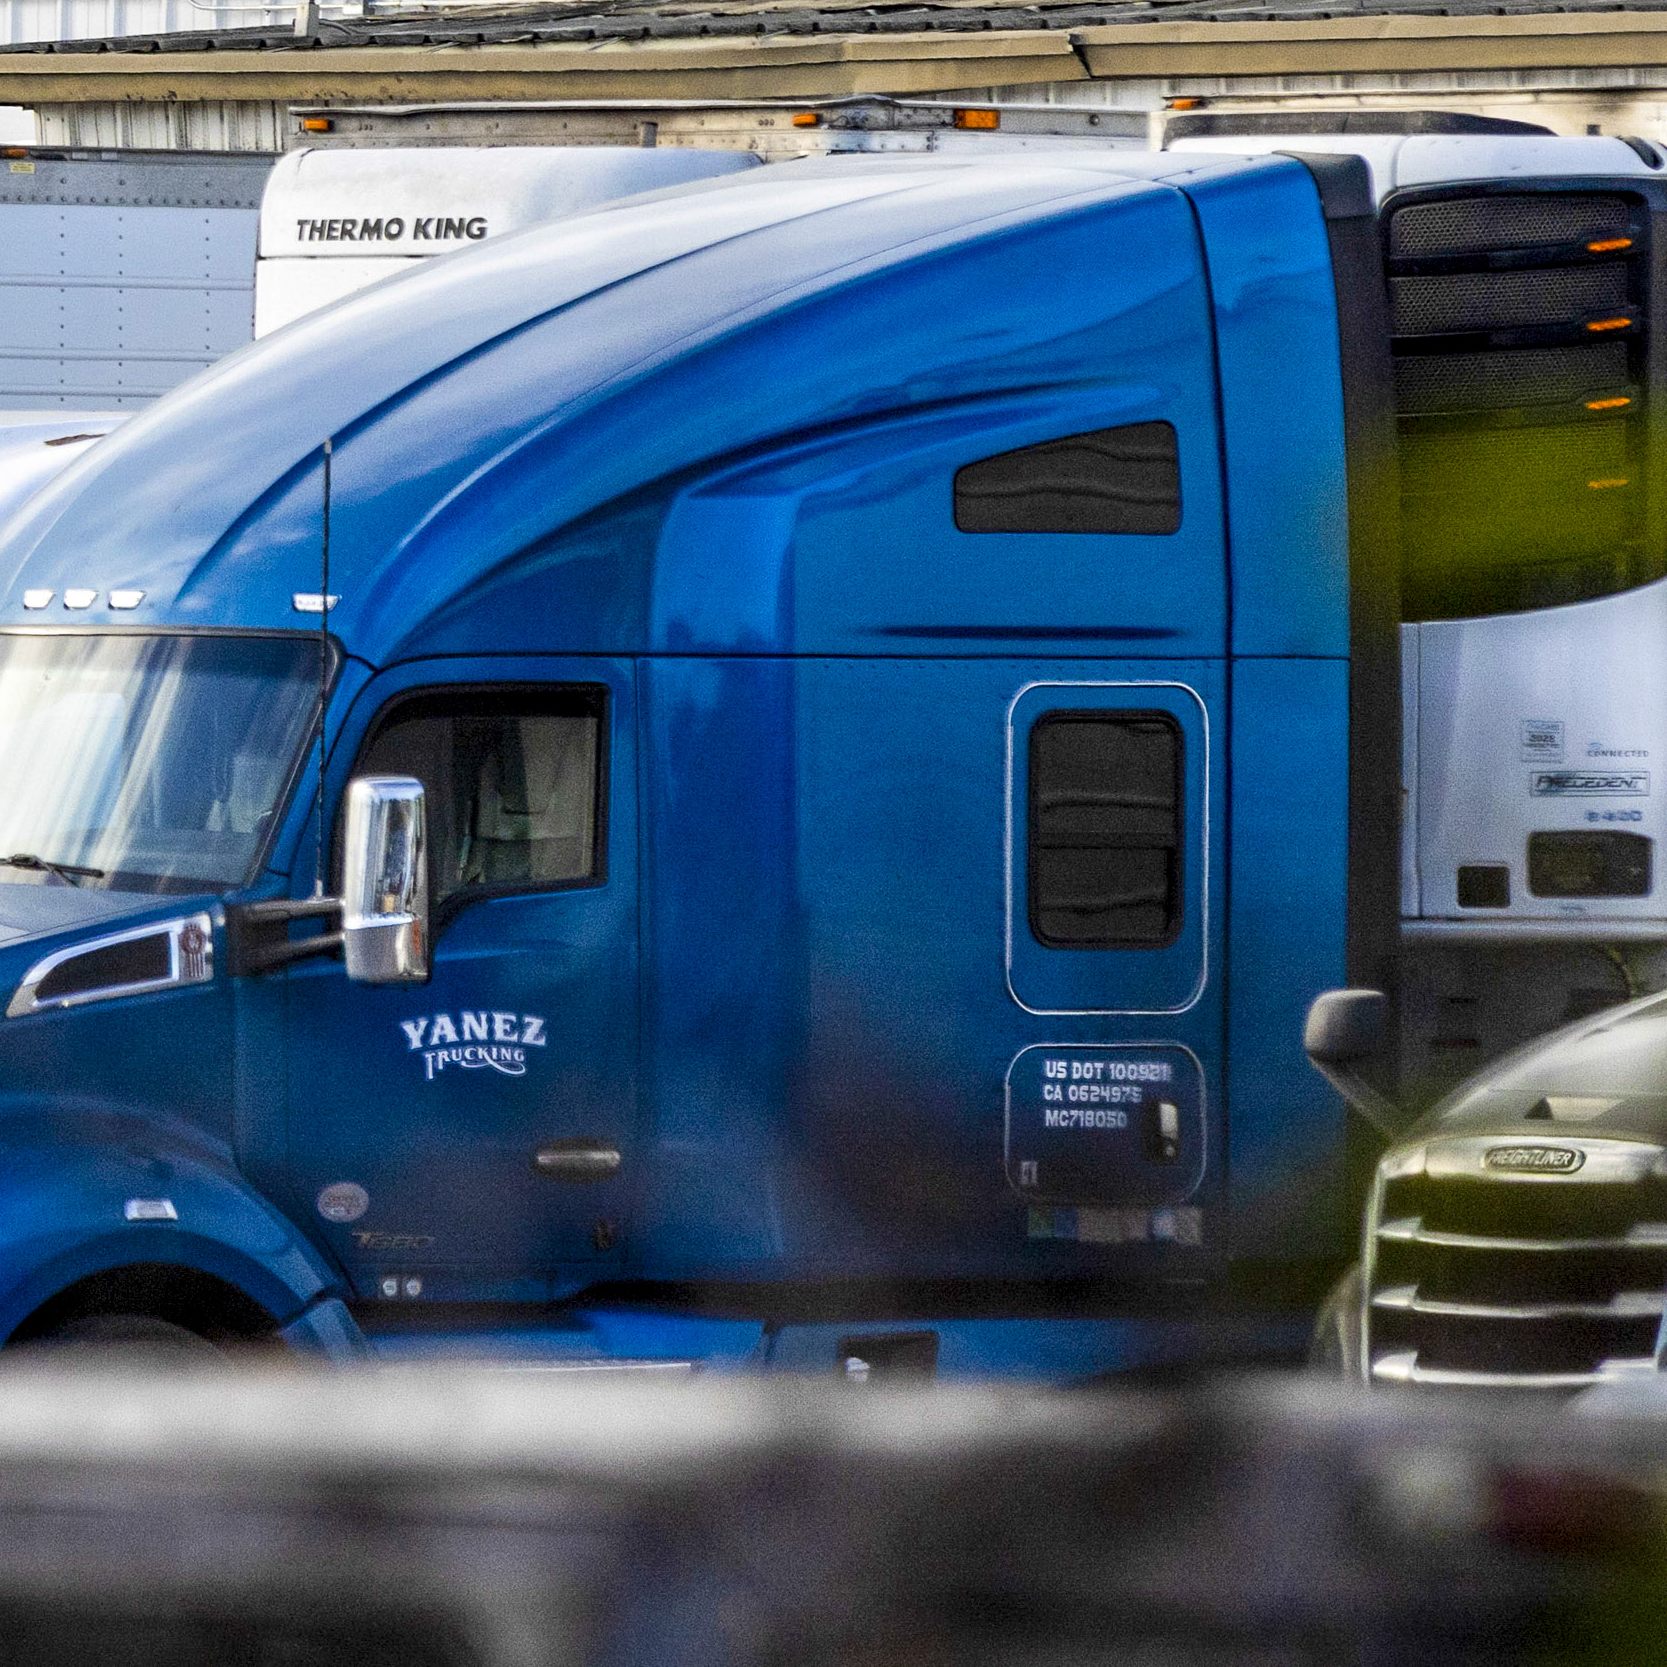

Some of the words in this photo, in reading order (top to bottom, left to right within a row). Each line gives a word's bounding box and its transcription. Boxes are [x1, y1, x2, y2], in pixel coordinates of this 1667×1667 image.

[297, 217, 405, 242] THERMO
[413, 216, 489, 241] KING
[401, 1010, 547, 1050] YANEZ
[424, 1046, 527, 1080] TRUCKING
[1045, 1060, 1068, 1079] US
[1071, 1061, 1104, 1080] DOT
[1043, 1084, 1063, 1102] CA
